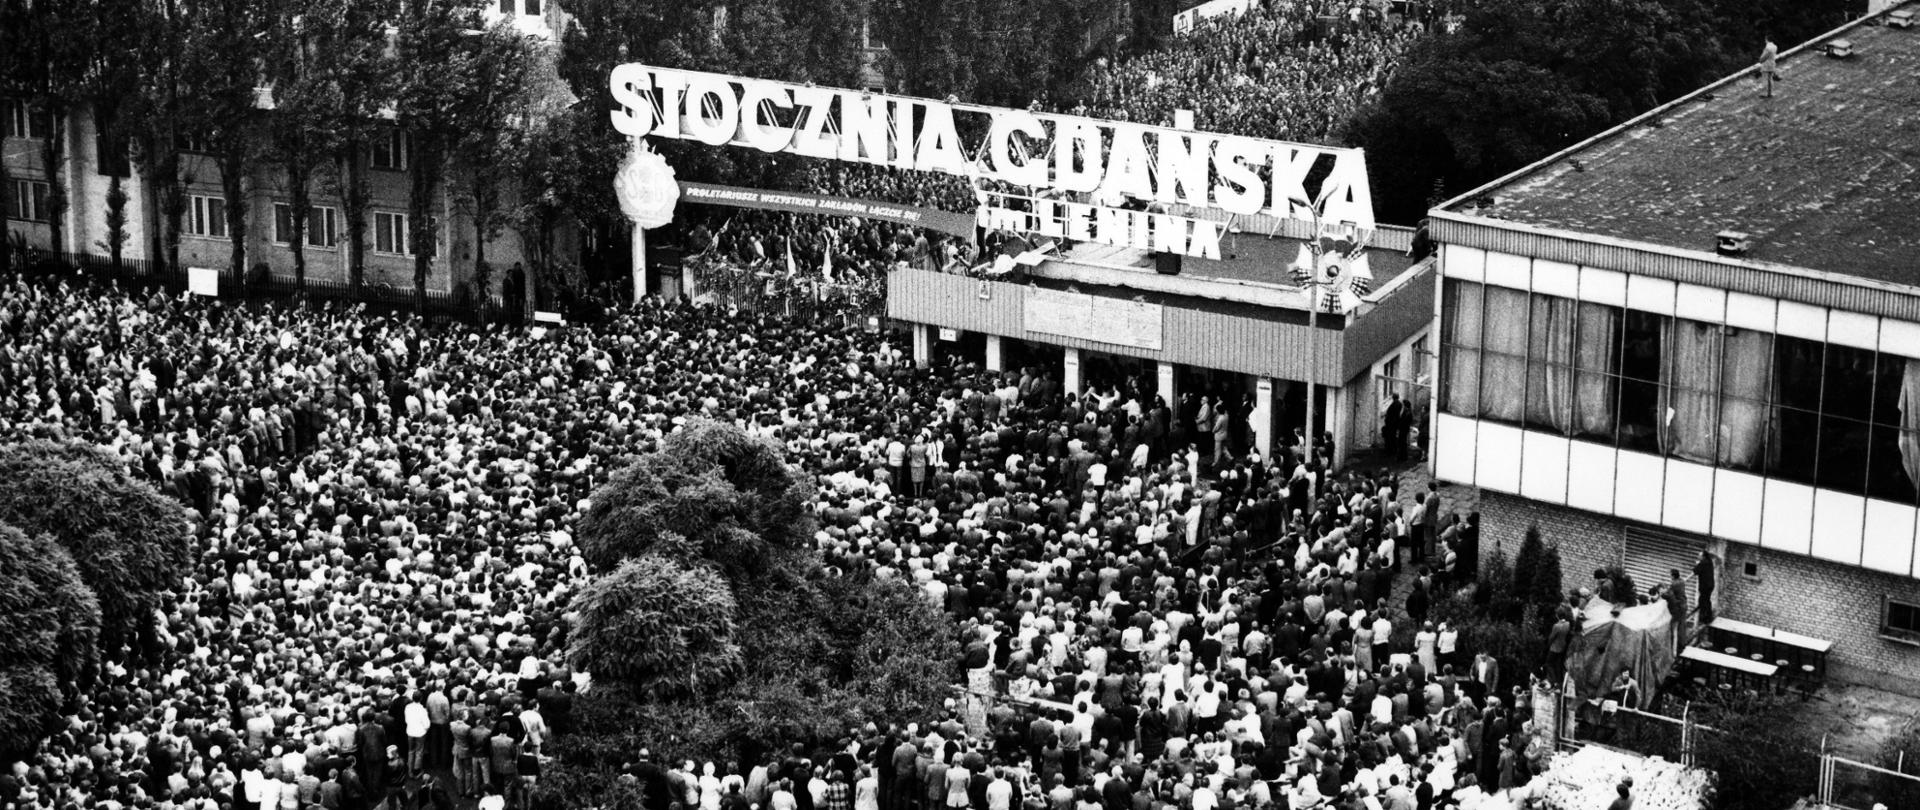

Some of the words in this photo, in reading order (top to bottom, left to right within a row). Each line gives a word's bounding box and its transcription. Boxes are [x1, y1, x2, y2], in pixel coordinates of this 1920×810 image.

[610, 63, 965, 175] STOCZNIA
[990, 110, 1374, 230] GDAŃSKA
[686, 187, 758, 201] PROLETARIUSZE
[760, 194, 816, 207] WSZYSTKICH
[1040, 200, 1221, 260] LENINA
